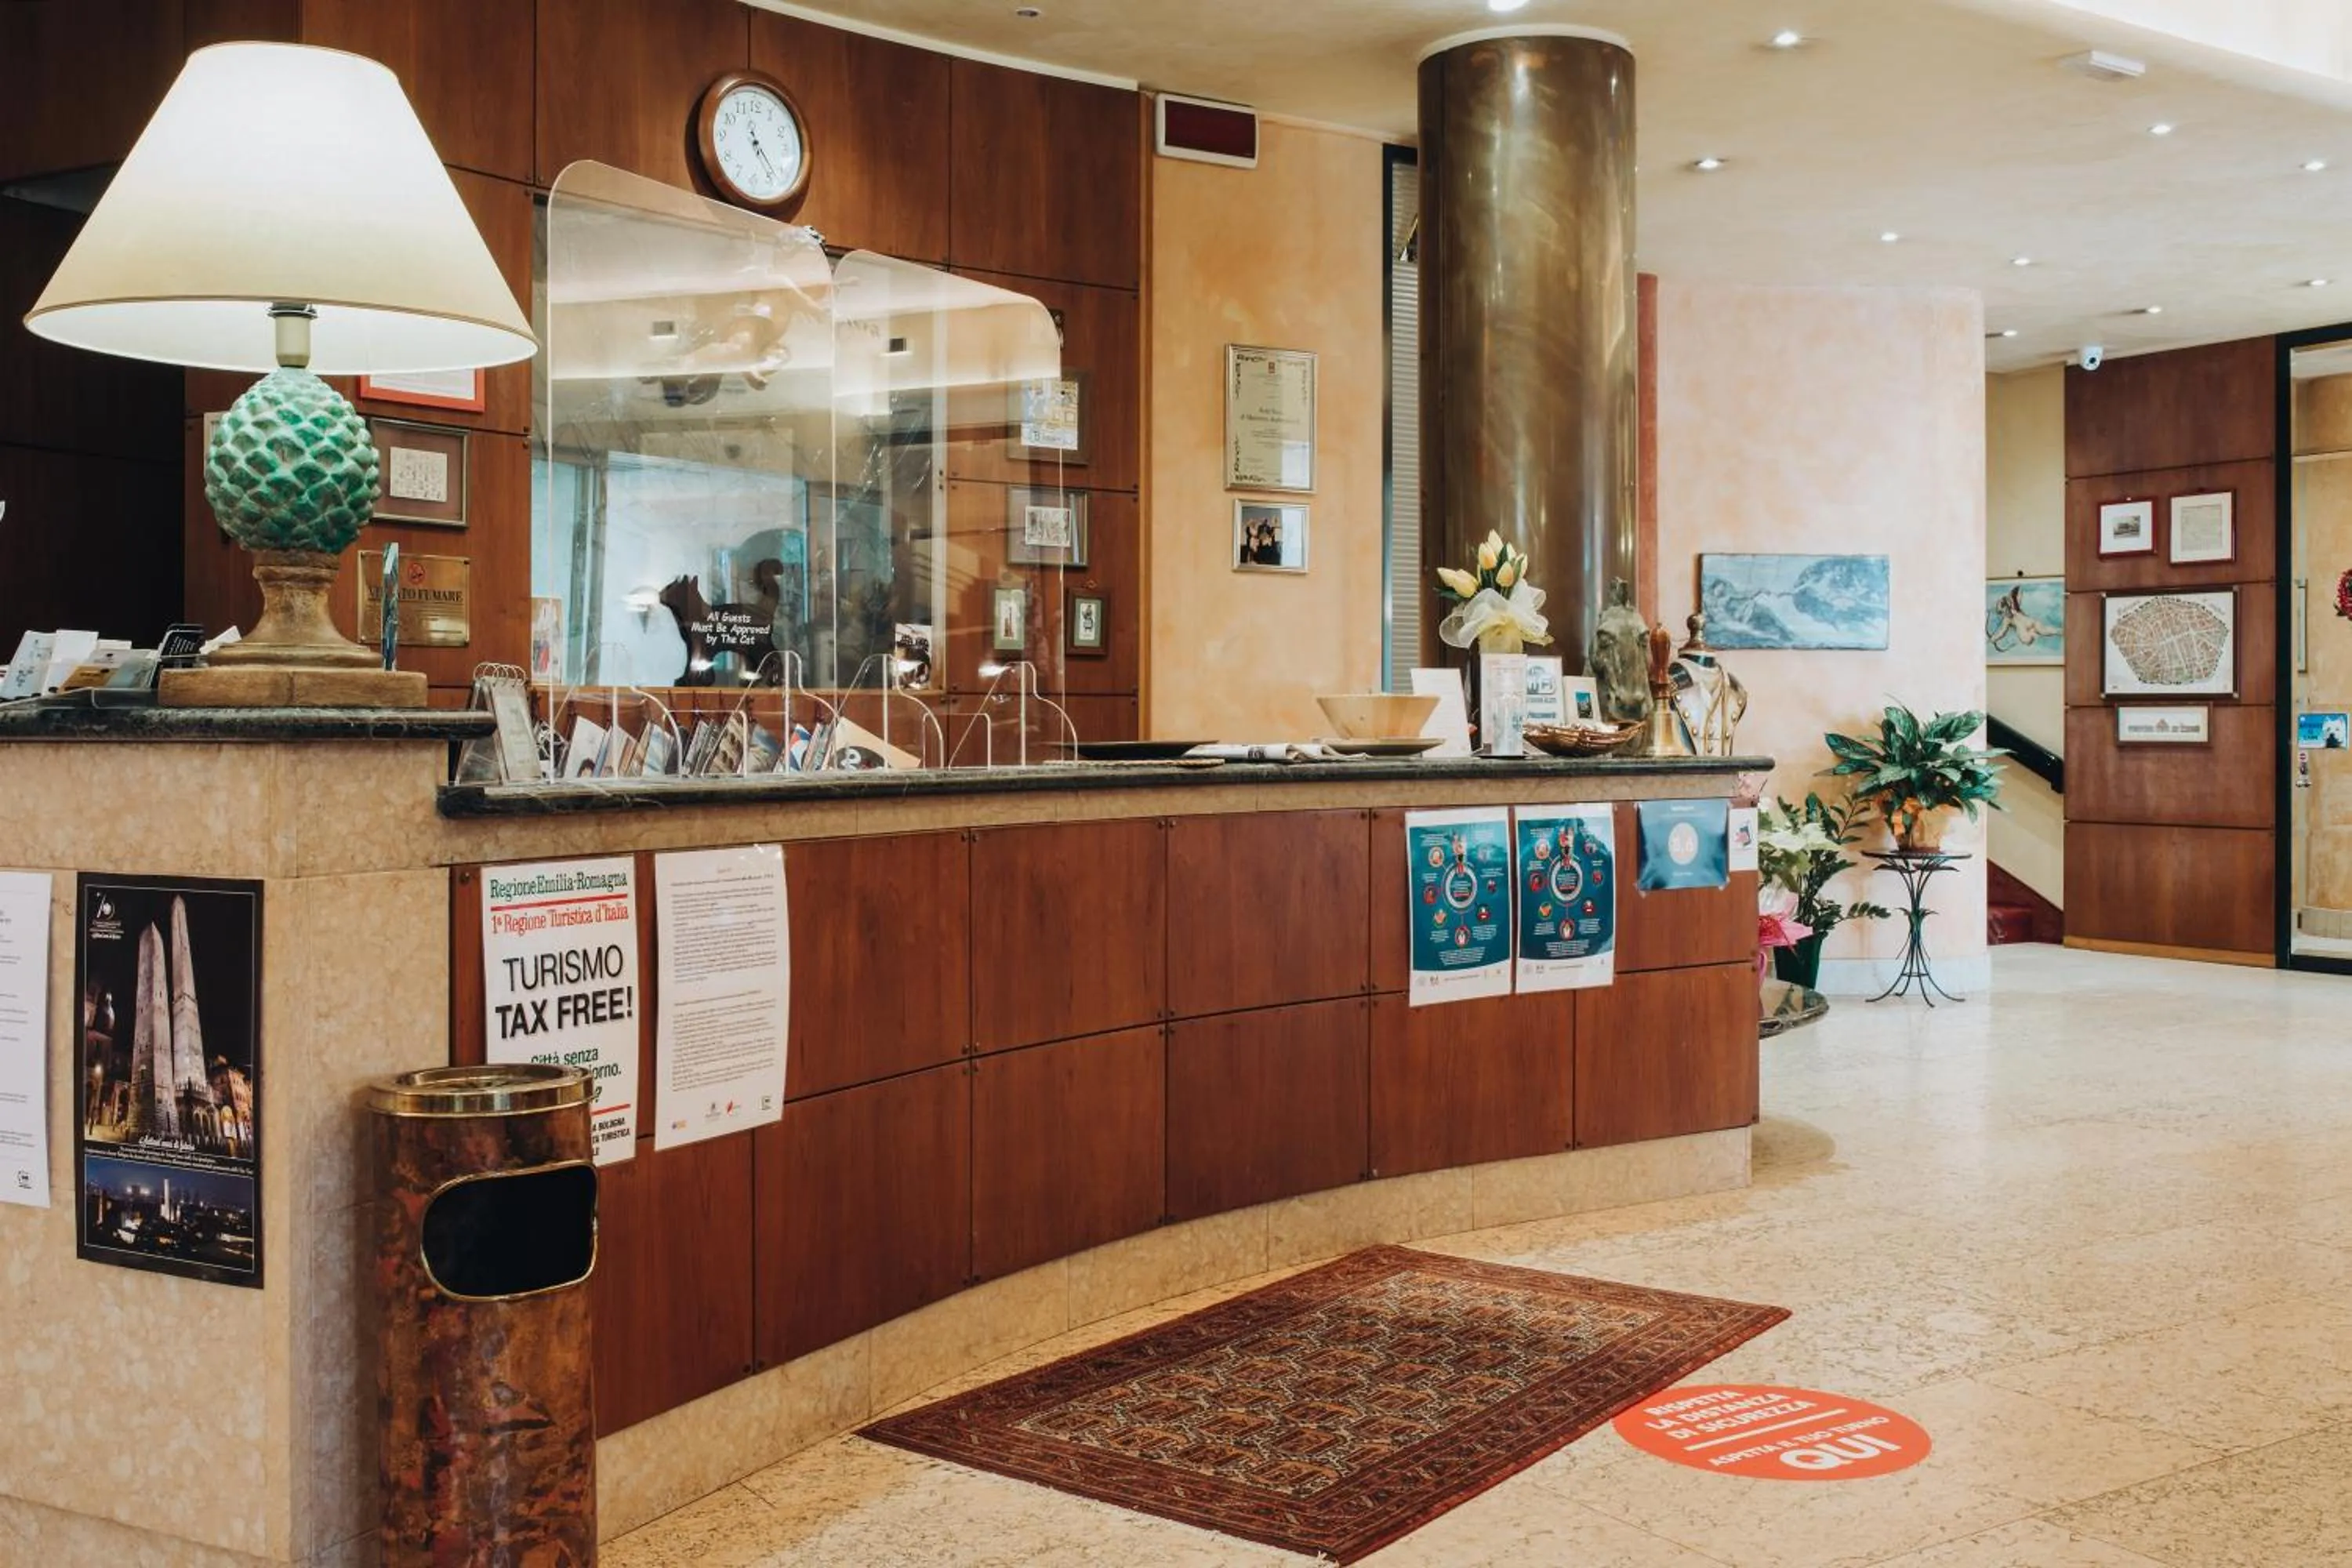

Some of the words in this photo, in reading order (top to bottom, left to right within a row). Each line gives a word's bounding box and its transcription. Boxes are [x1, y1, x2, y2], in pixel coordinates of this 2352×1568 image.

[735, 101, 746, 114] 11
[750, 100, 761, 114] 12
[724, 112, 736, 125] 10
[719, 129, 727, 142] 9
[777, 125, 784, 139] 2
[369, 586, 416, 600] VITO
[419, 589, 463, 602] FUMARE
[706, 611, 720, 622] All
[721, 612, 752, 623] Guests
[691, 622, 713, 633] Must
[717, 622, 728, 633] Be
[731, 624, 771, 636] Approved
[706, 633, 717, 647] by
[720, 633, 738, 644] The
[740, 635, 756, 645] Cat
[504, 912, 546, 936] Regione
[547, 907, 593, 928] Turistica
[503, 944, 624, 992] TURISMO
[495, 999, 549, 1039] TAX
[557, 985, 633, 1029] FREE!
[564, 1048, 598, 1065] senza
[1643, 1390, 1745, 1416] RISPETTA
[1644, 1417, 1683, 1430] LA
[1675, 1393, 1791, 1422] DISTANZA
[1666, 1428, 1700, 1440] DI
[1695, 1400, 1817, 1432] SICUREZZA
[1708, 1444, 1782, 1467] ASPETTA
[1776, 1439, 1799, 1449] IL
[1793, 1430, 1833, 1443] TUO
[1829, 1416, 1890, 1434] TURNO
[1779, 1433, 1903, 1470] QUI
